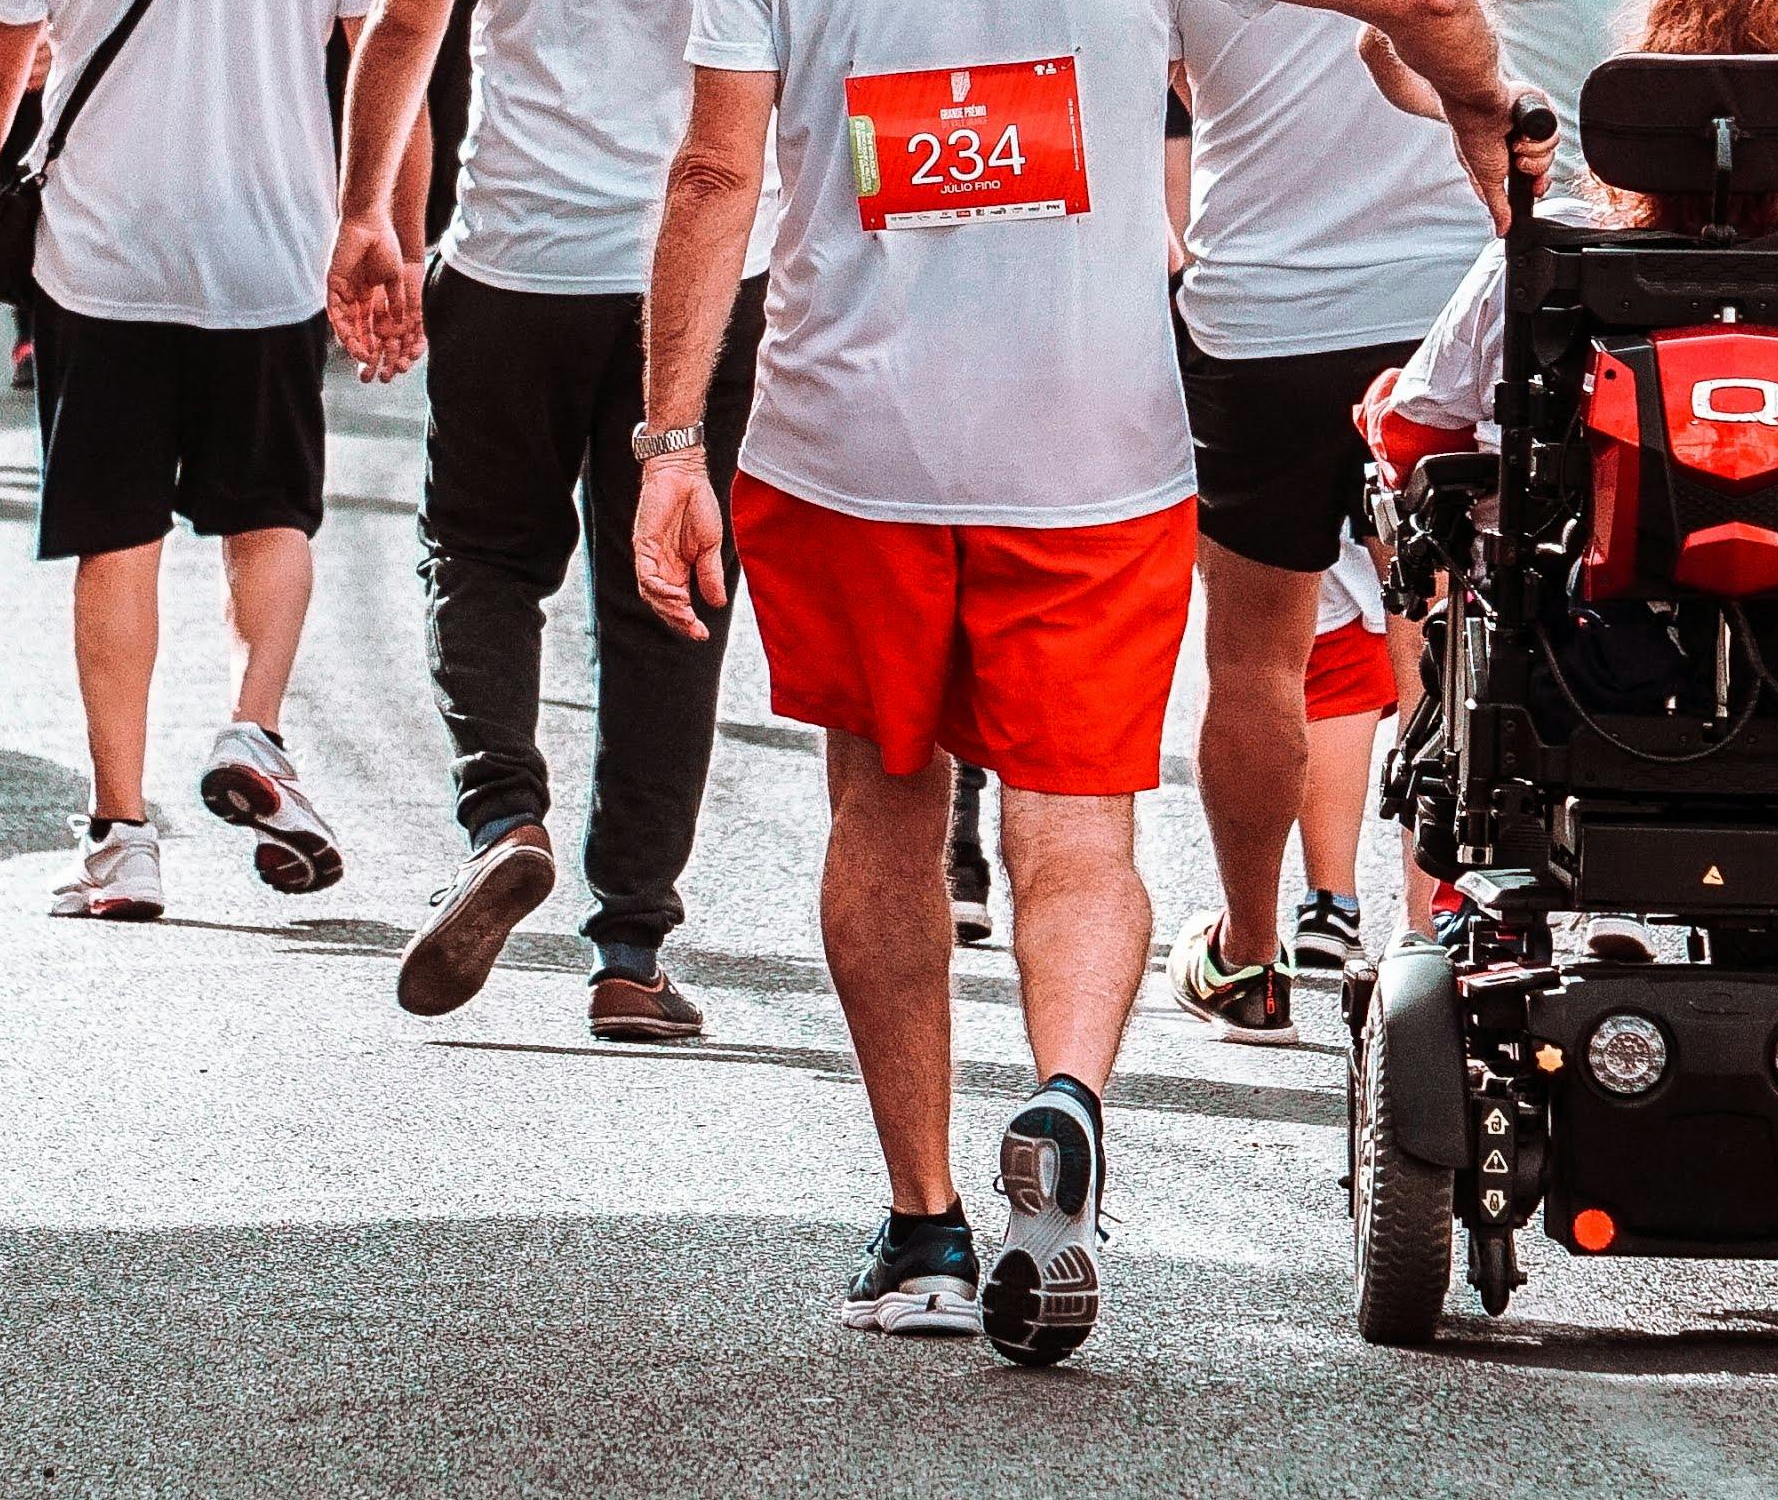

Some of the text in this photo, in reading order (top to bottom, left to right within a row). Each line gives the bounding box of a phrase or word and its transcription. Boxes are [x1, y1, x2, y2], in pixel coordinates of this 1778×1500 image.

[907, 124, 1026, 185] 234
[940, 180, 1001, 194] JÚLIO FINO
